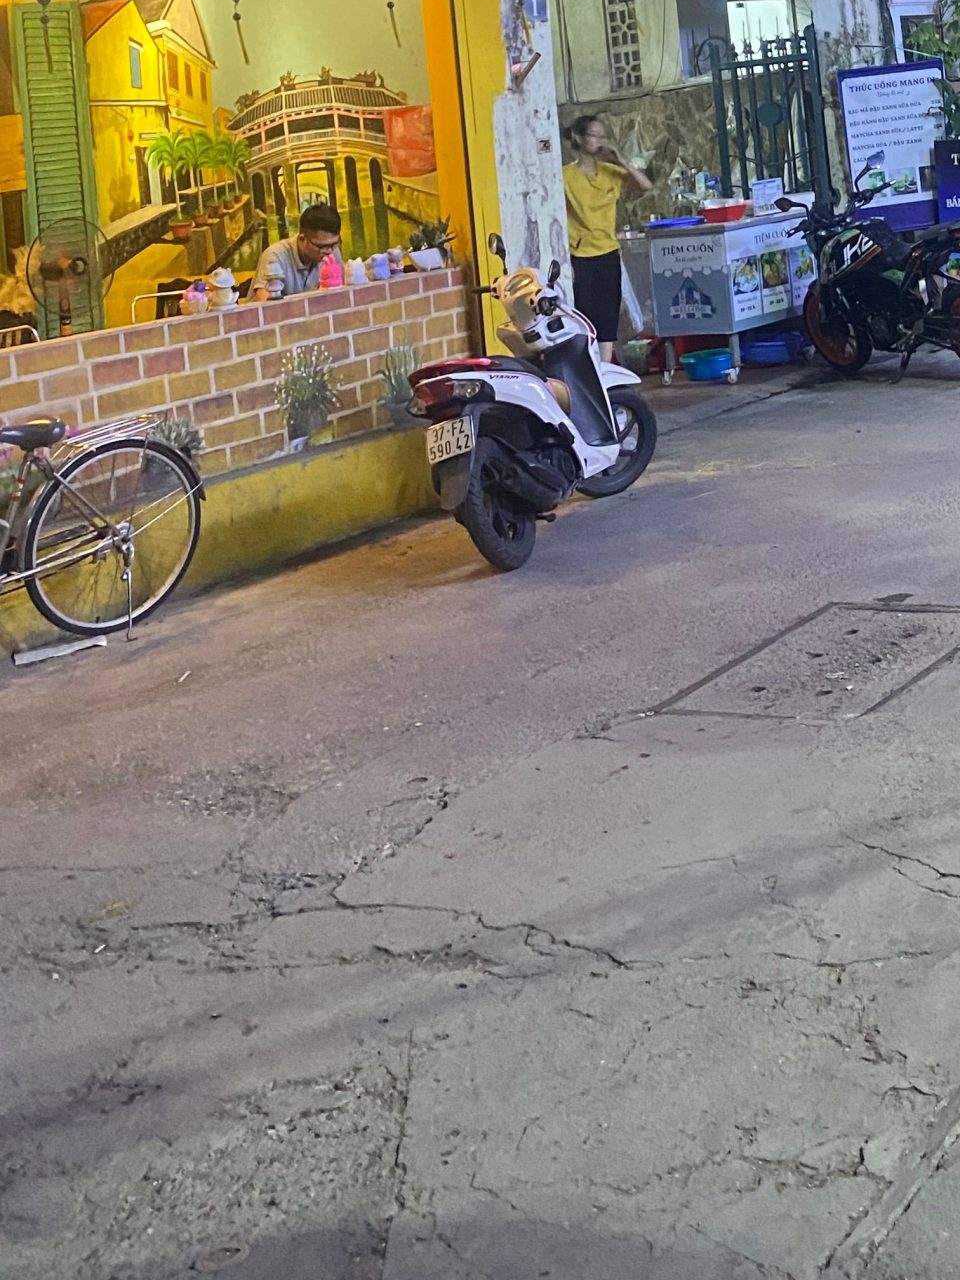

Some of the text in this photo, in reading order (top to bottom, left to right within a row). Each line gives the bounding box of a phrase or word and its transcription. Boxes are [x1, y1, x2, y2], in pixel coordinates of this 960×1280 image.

[849, 81, 873, 93] THỨC
[874, 80, 898, 90] UỐNG
[899, 77, 925, 87] MANG
[661, 242, 714, 256] TIỆM CUỐN
[432, 419, 465, 443] 37-F2
[430, 434, 470, 461] 590.42
